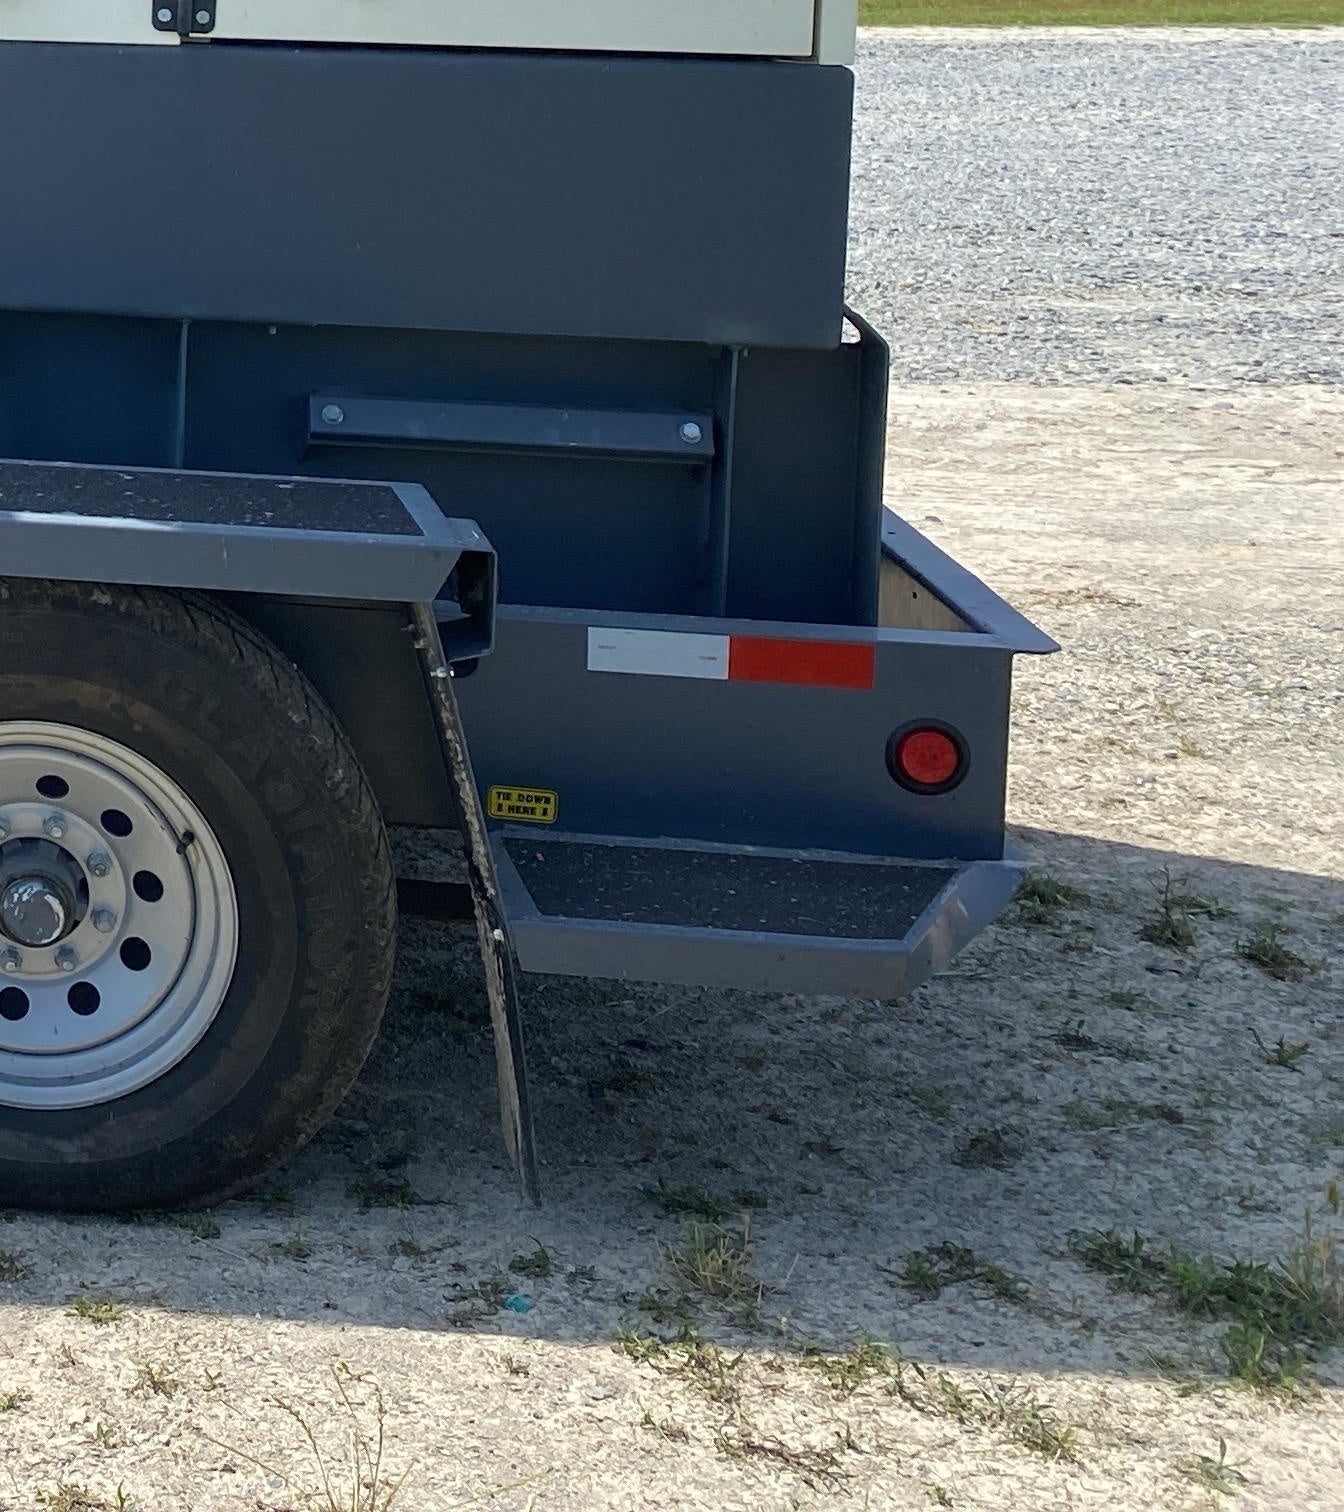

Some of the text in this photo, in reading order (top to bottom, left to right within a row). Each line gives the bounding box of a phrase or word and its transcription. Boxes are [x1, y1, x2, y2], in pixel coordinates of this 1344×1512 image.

[495, 790, 551, 804] TIE DOWN
[507, 806, 537, 816] HERE
